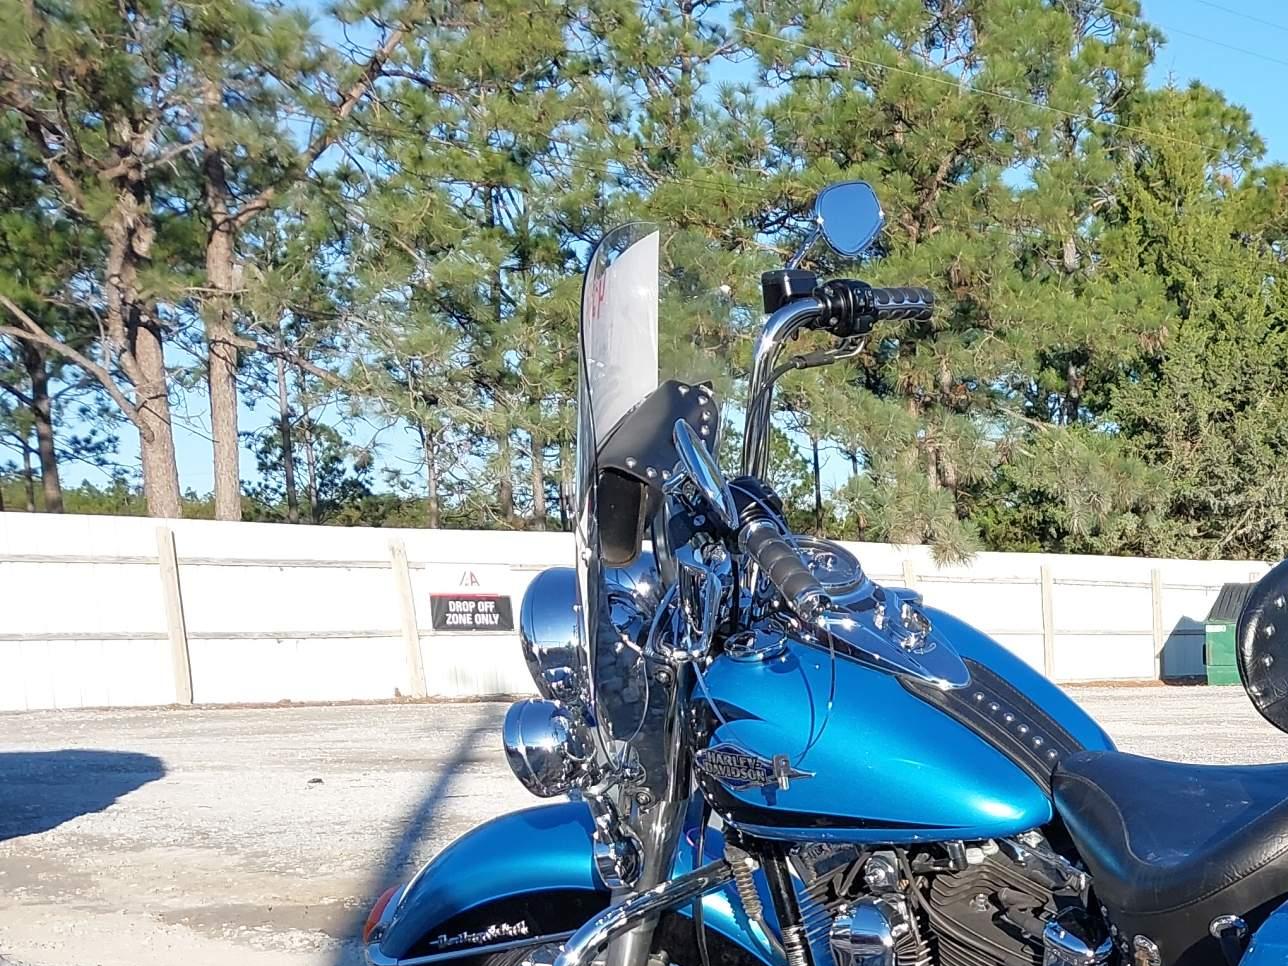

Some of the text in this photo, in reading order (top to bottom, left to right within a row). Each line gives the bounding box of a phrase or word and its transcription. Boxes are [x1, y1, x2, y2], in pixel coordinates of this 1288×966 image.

[448, 601, 495, 612] DROP OFF
[446, 613, 500, 625] ZONE ONLY
[705, 762, 767, 781] DAVIDSON
